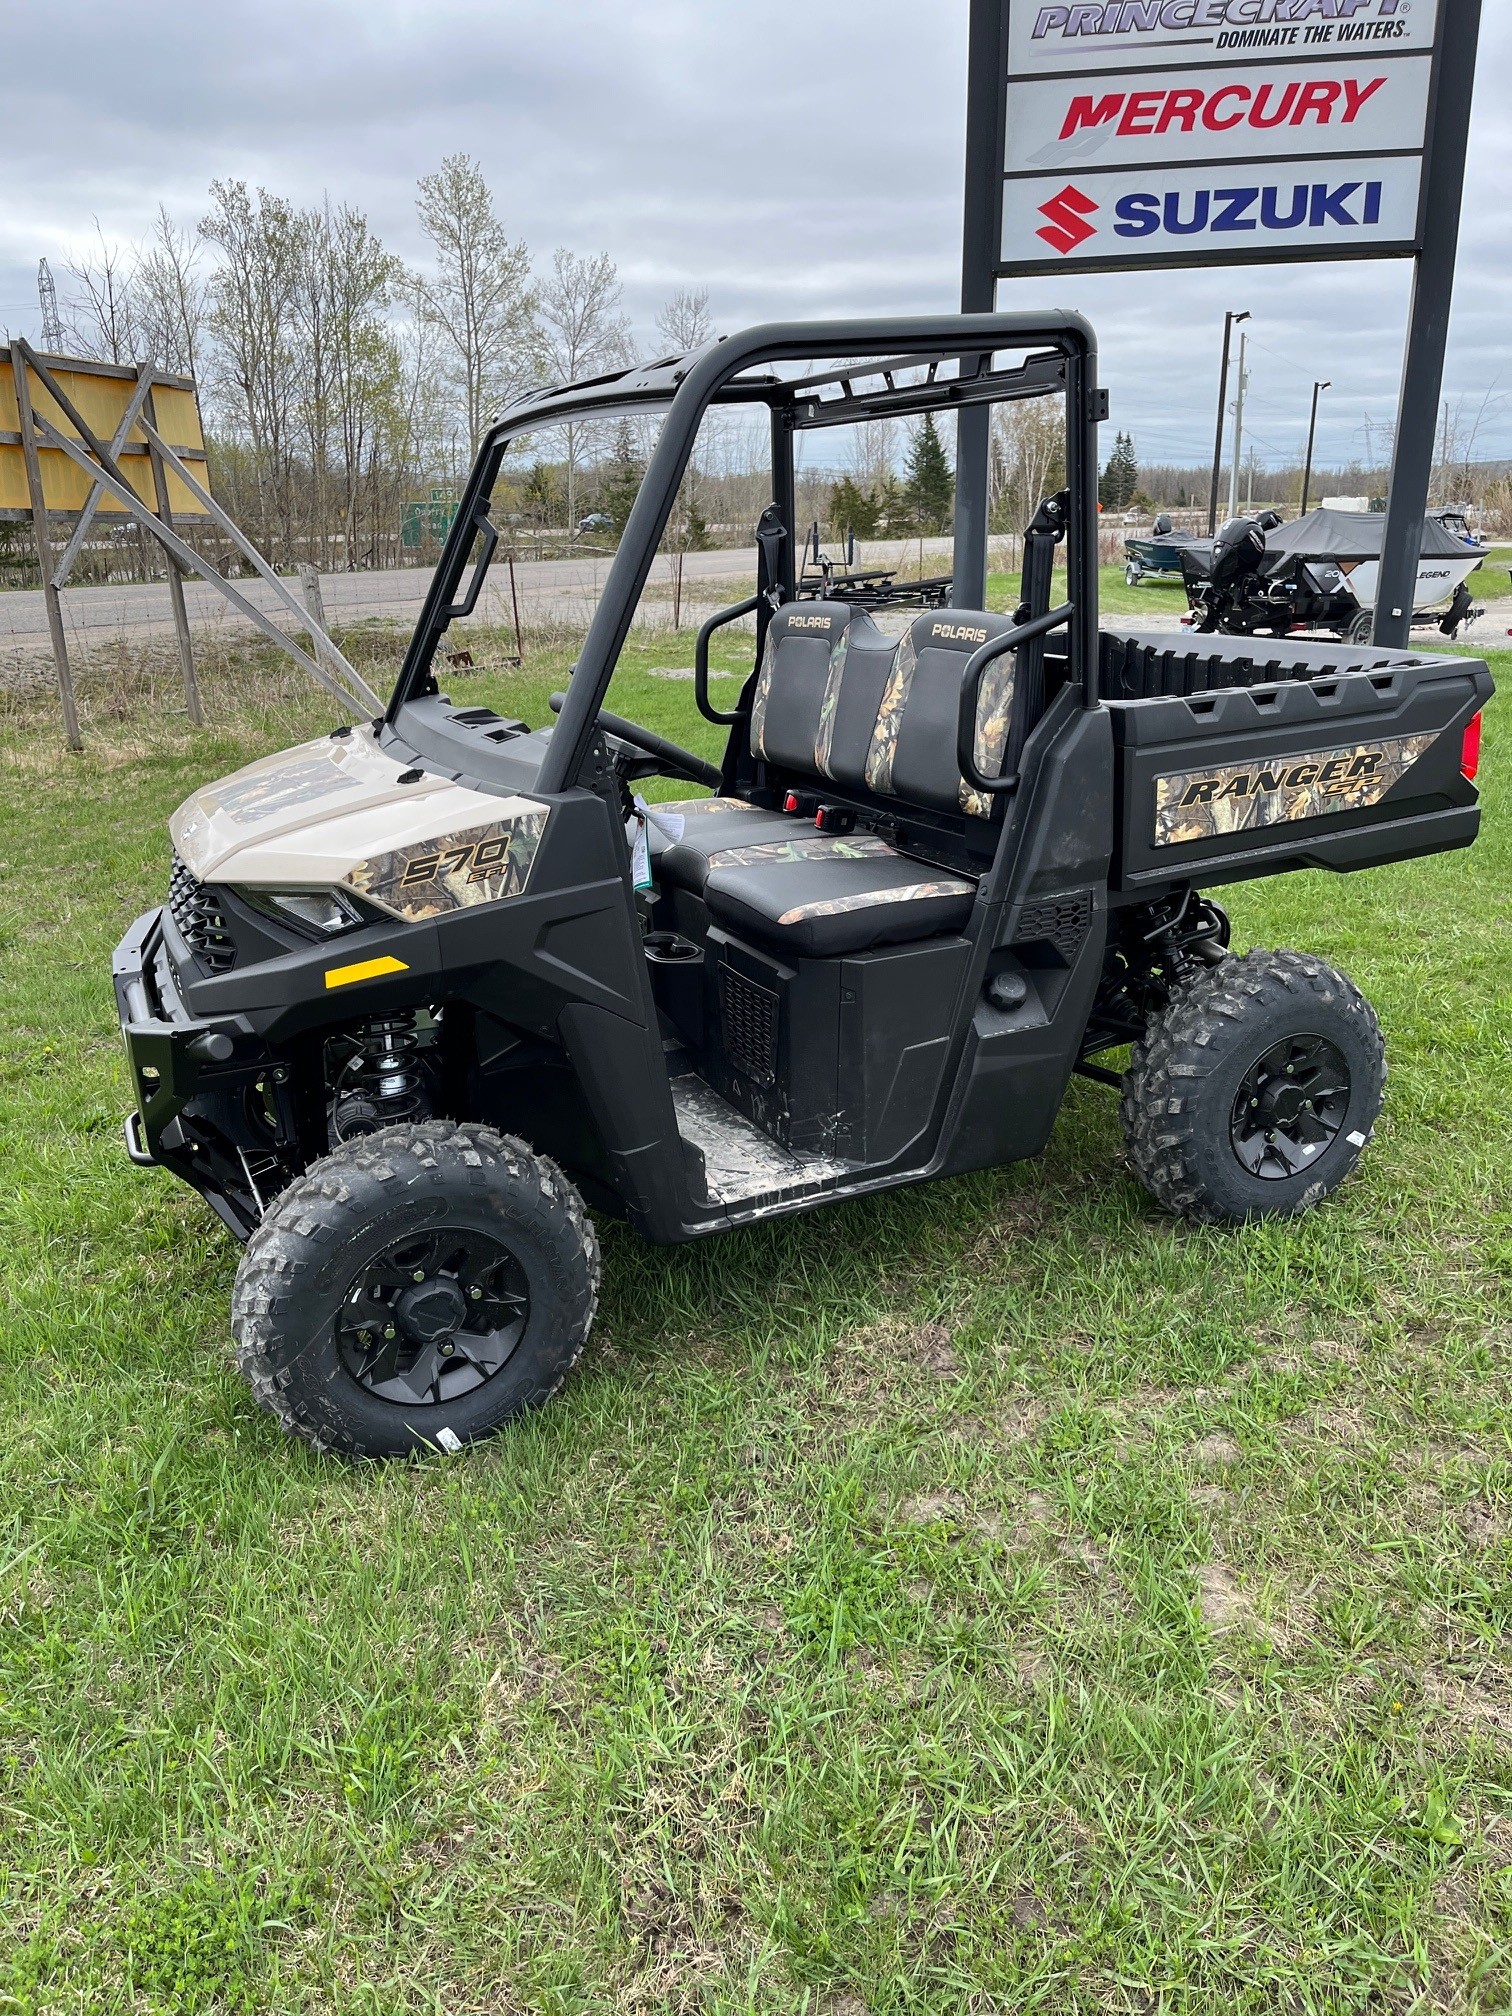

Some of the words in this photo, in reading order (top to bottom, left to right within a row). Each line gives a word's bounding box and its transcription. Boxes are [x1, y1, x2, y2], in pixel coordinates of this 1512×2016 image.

[1216, 27, 1299, 49] DOMINATE
[1303, 25, 1334, 44] THE
[1337, 20, 1405, 42] WATERS
[1058, 77, 1388, 140] MERCURY
[1113, 181, 1383, 238] SUZUKI
[1416, 571, 1450, 579] EGEND
[788, 616, 831, 629] POLARIS
[932, 623, 987, 642] POLARIS
[1178, 752, 1384, 808] RANGER
[1322, 774, 1386, 798] SP
[400, 835, 511, 888] 570
[466, 863, 509, 884] EFI
